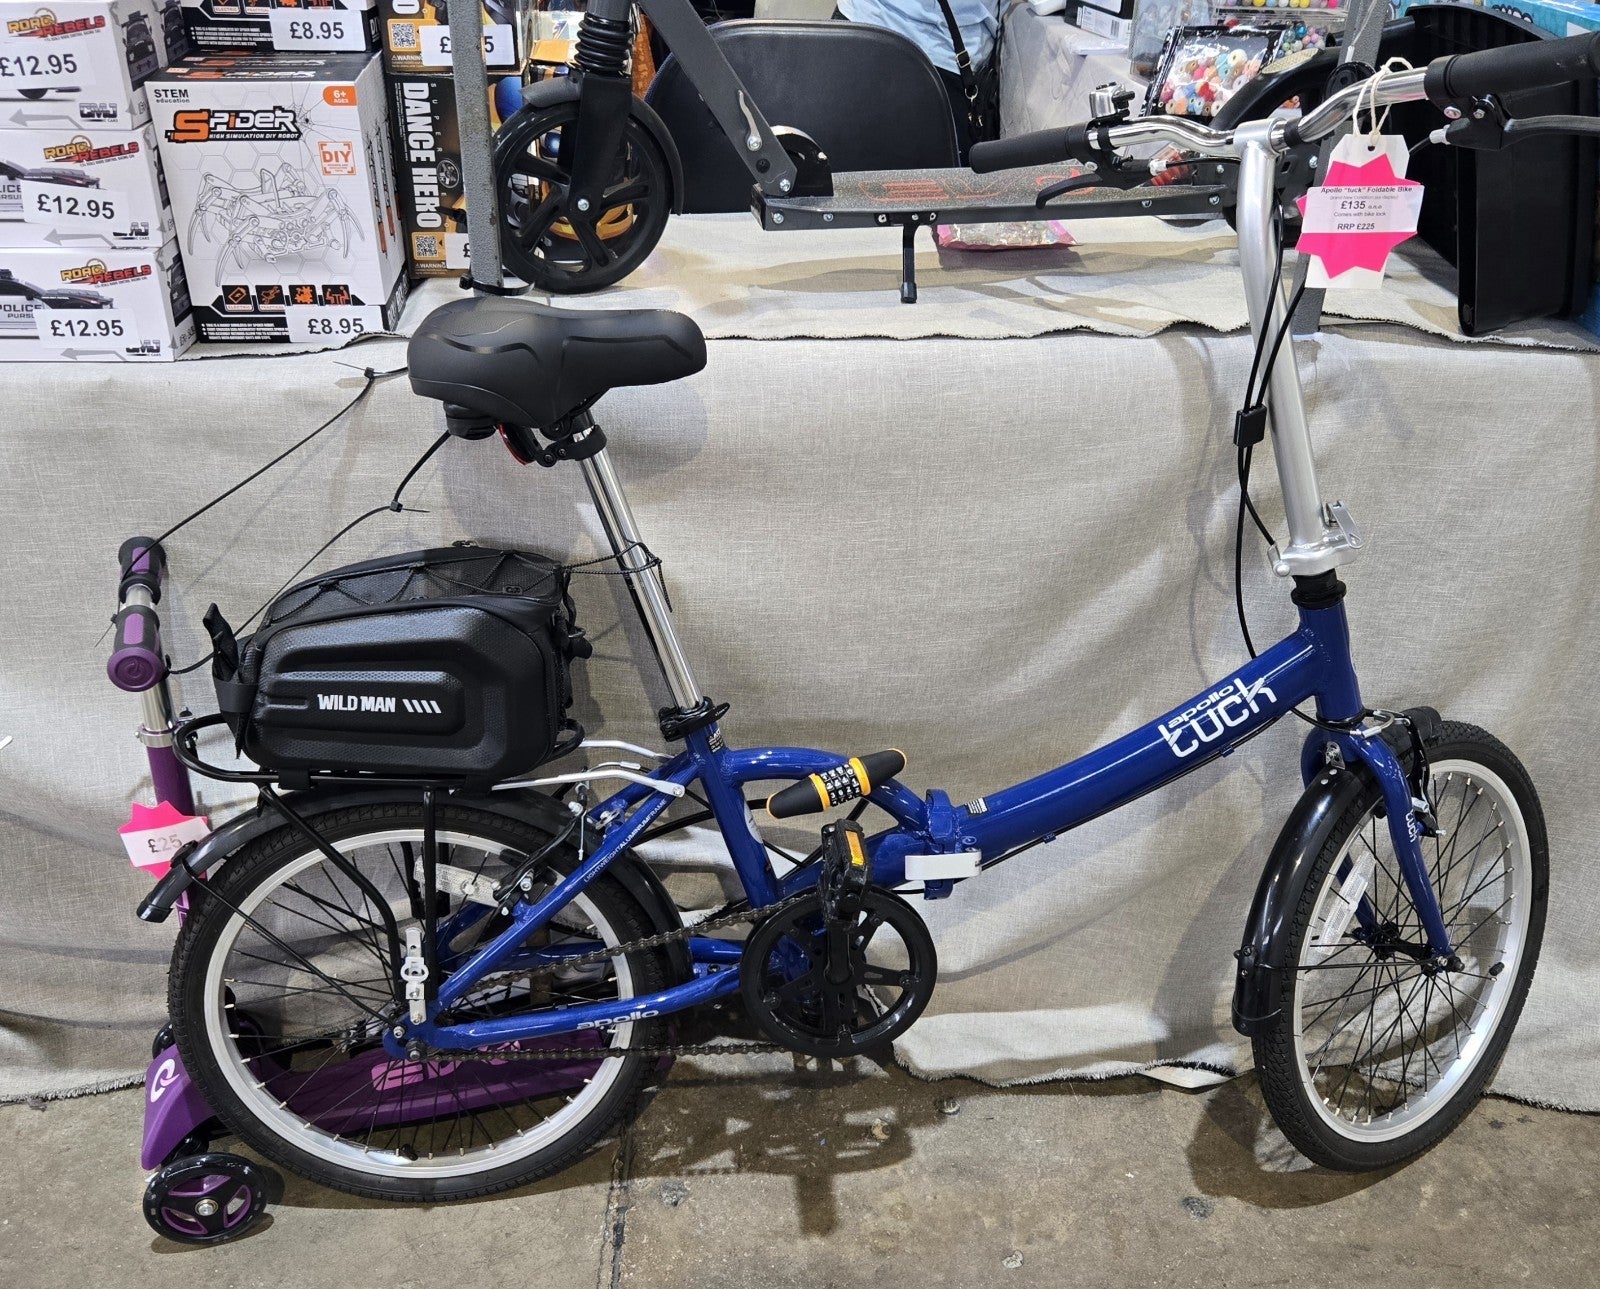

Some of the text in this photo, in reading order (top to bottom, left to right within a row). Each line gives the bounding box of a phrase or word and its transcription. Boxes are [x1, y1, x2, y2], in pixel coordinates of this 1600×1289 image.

[7, 15, 56, 34] ROAD
[42, 15, 106, 38] REBELS
[290, 21, 344, 40] £8.95
[0, 54, 78, 77] £12.95
[154, 89, 189, 98] STEM
[333, 89, 347, 98] 6+
[402, 82, 436, 162] DANCE
[44, 141, 91, 160] ROAD
[78, 141, 140, 163] REBELS
[322, 150, 351, 163] DIY
[37, 194, 115, 220] £12.95
[411, 167, 442, 228] HERO
[1340, 200, 1366, 210] £135
[1337, 222, 1376, 231] RRP £225
[60, 264, 107, 282] ROAD
[93, 264, 152, 285] REBELS
[51, 319, 124, 337] £12.95
[308, 317, 364, 335] £8.95
[317, 693, 396, 713] WILD MAN
[1168, 685, 1235, 729] apollo
[1158, 678, 1278, 758] tuck
[1405, 808, 1418, 843] tuck
[147, 833, 183, 854] £25
[576, 1009, 660, 1030] apollo
